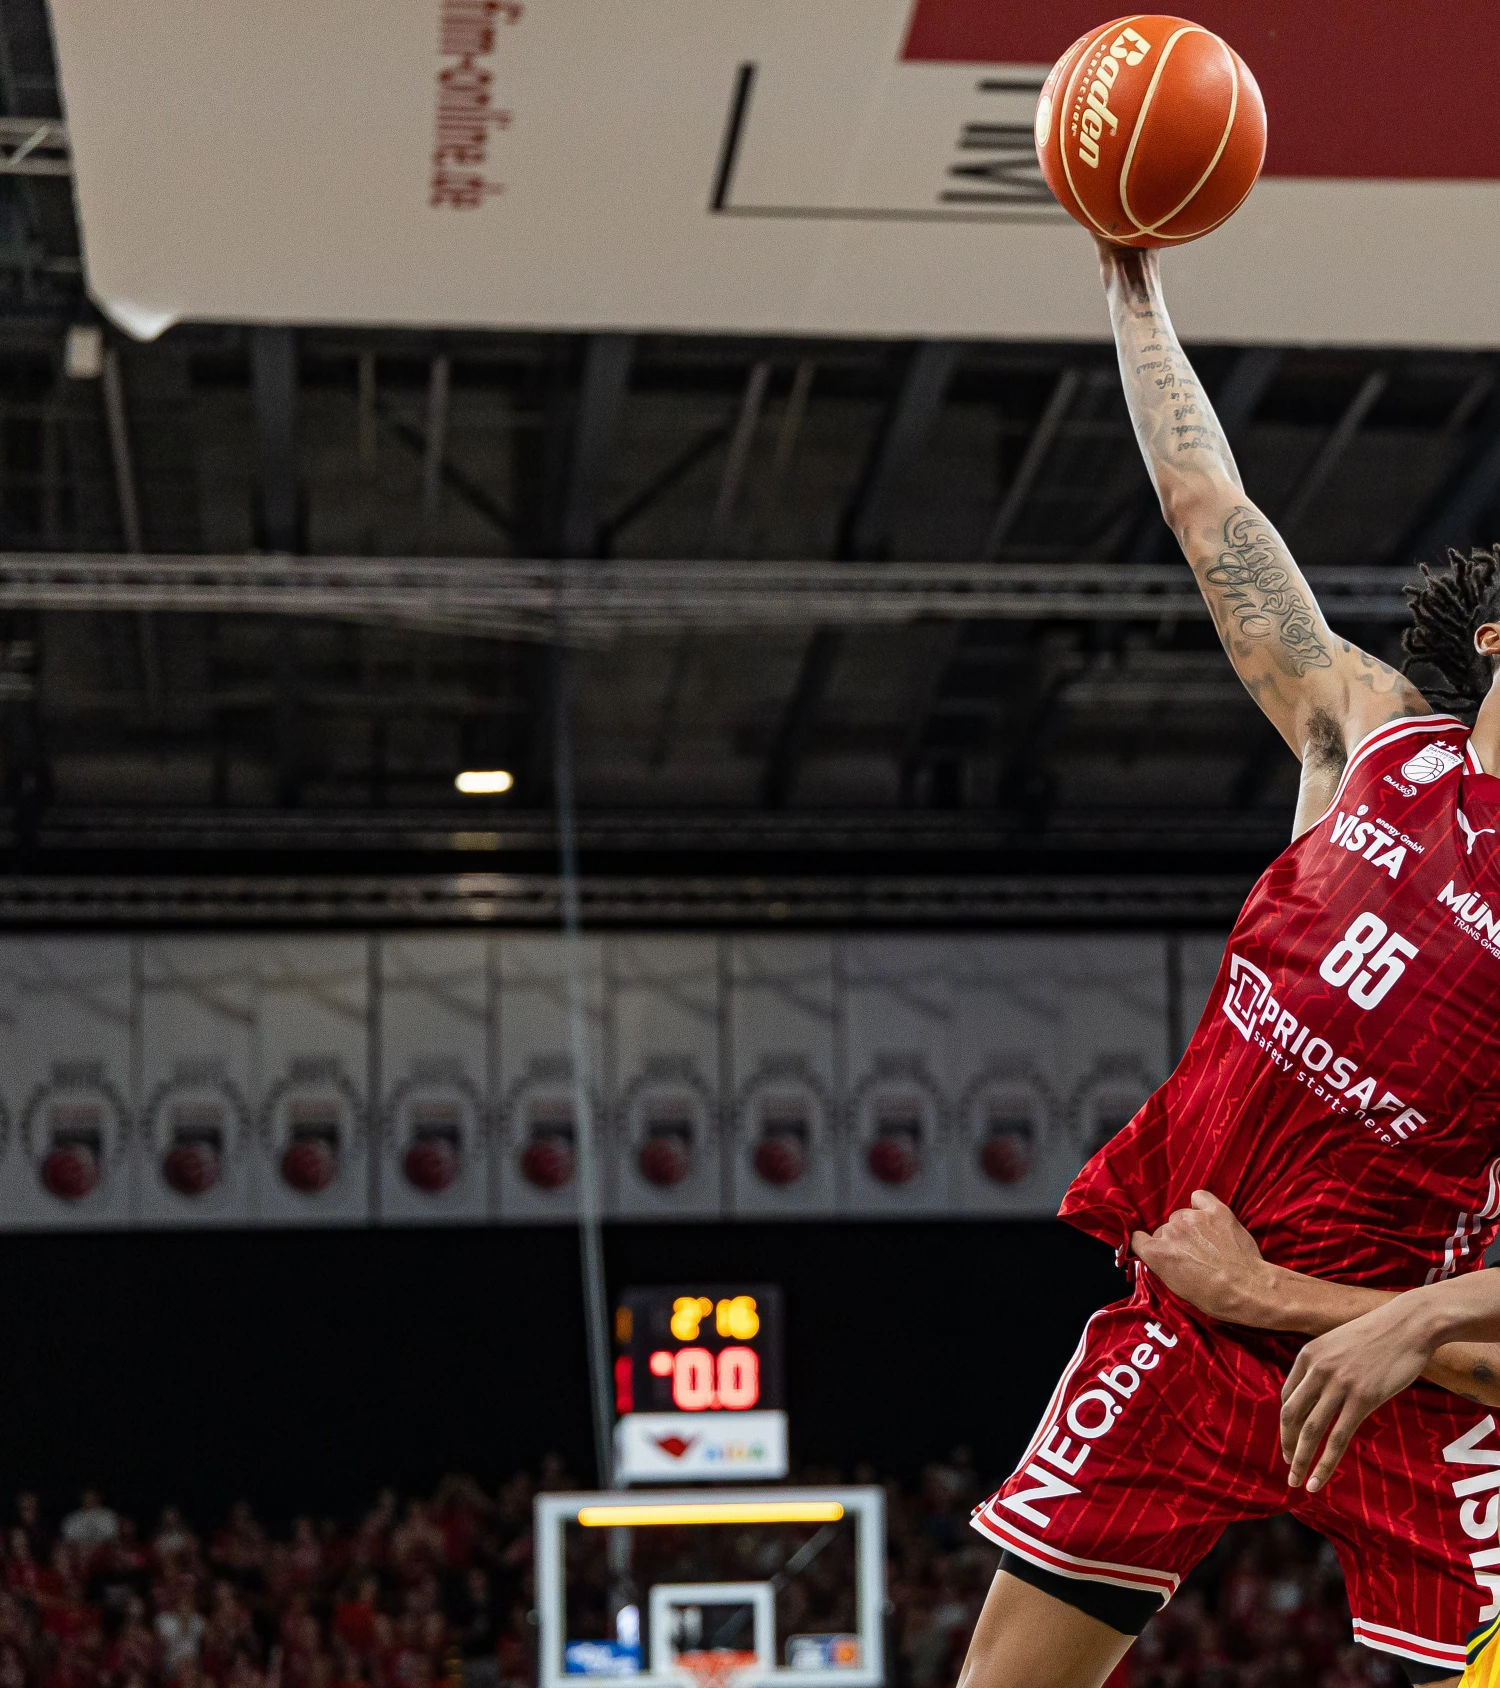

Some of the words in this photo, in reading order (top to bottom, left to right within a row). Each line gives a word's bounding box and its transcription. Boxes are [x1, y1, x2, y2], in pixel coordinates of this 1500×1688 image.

[1072, 44, 1107, 129] PERFECTION
[1079, 27, 1151, 168] Baden
[1329, 804, 1407, 880] VISTA
[1375, 817, 1401, 837] energy
[1400, 834, 1426, 854] GmbH
[1319, 912, 1420, 1010] 85
[1453, 916, 1481, 941] TRANS
[1253, 1030, 1293, 1072] safety
[1259, 995, 1427, 1140] PRIOSAFE
